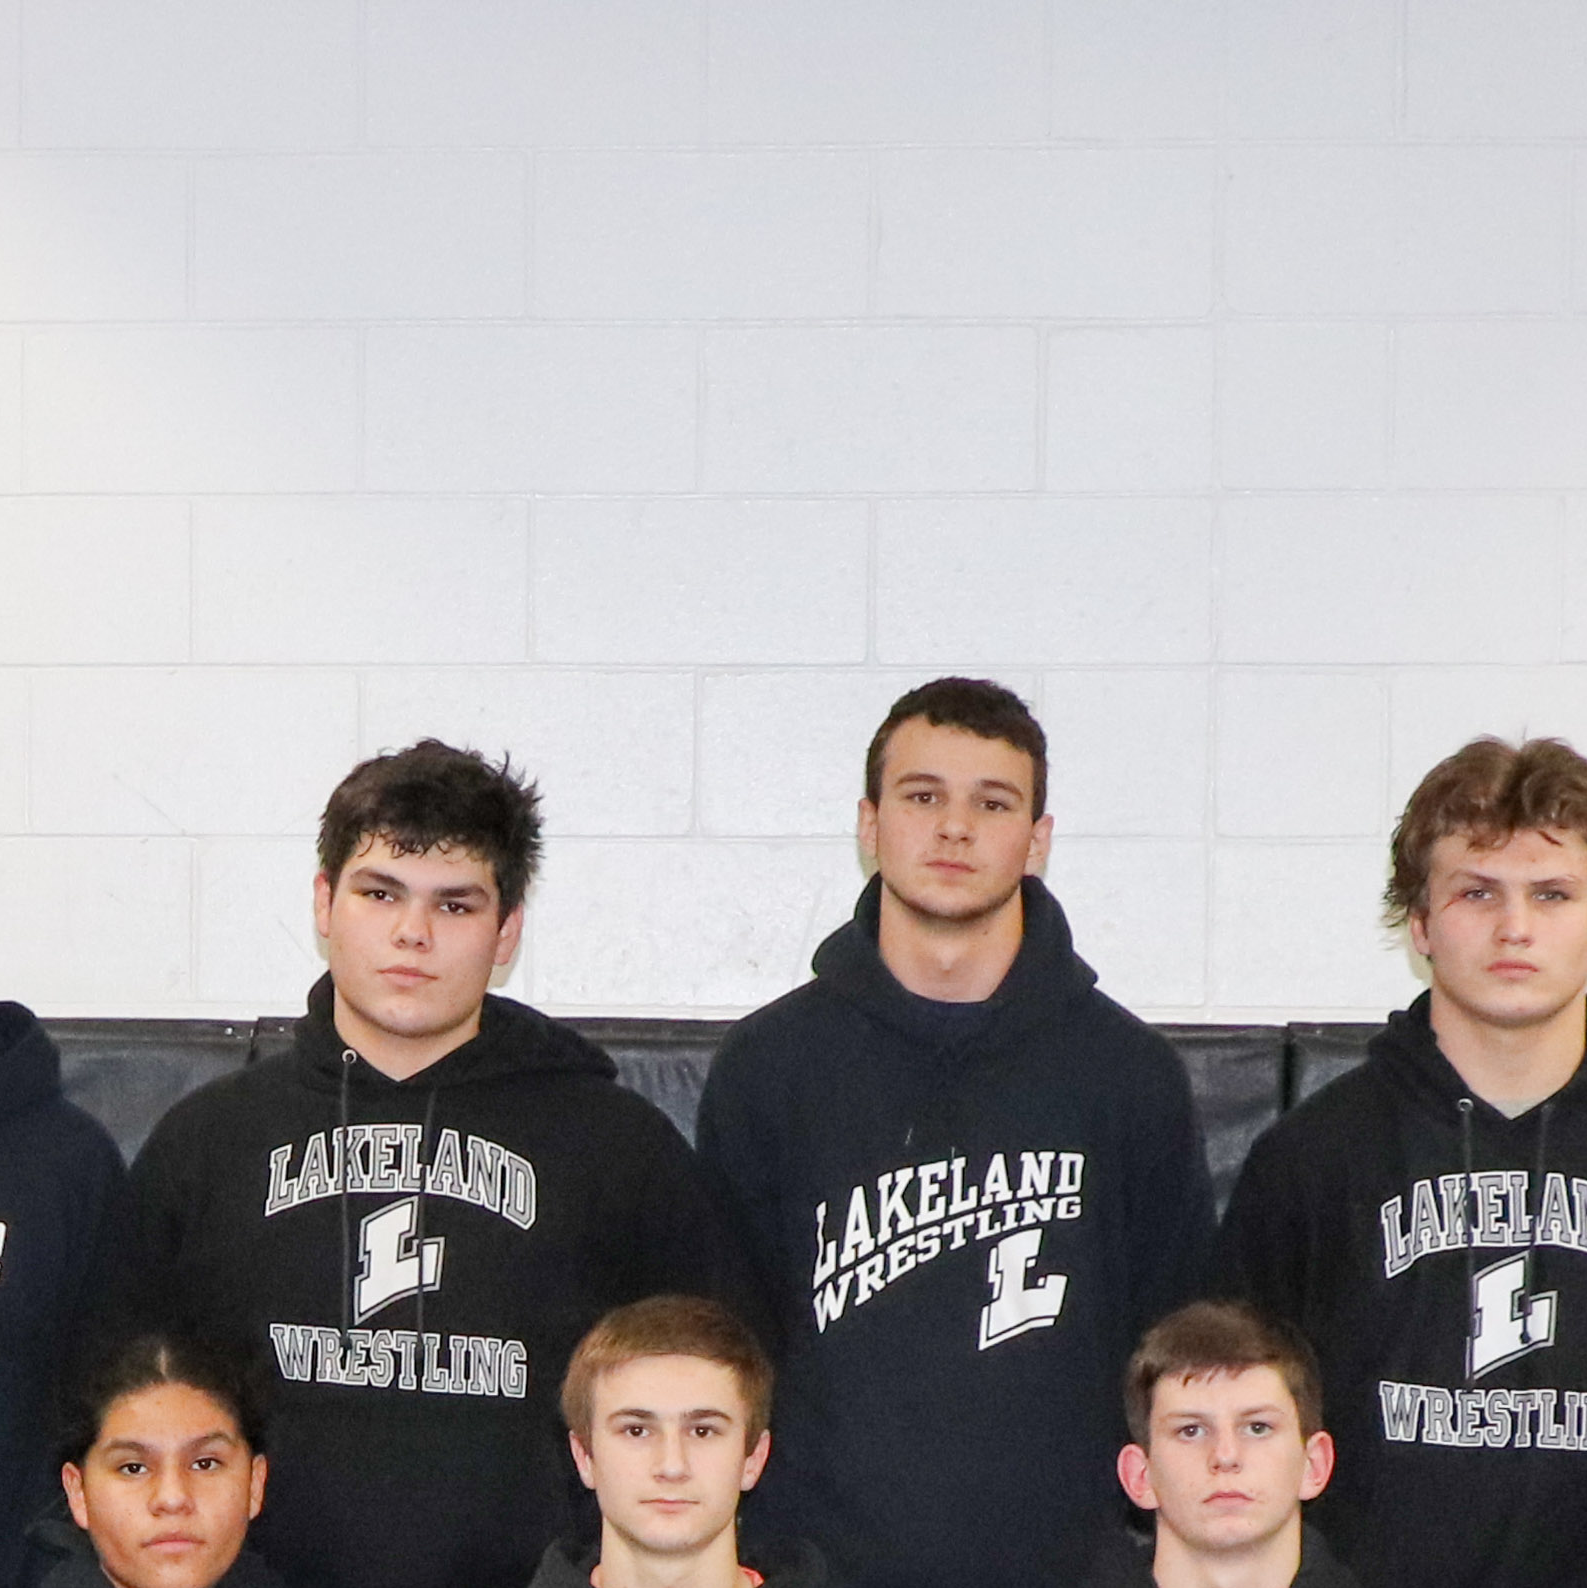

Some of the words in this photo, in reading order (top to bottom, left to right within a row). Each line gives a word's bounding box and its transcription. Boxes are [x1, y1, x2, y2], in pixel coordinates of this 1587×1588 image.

[264, 1123, 536, 1230] LAKELAND
[814, 1151, 1085, 1288] LAKELAND
[814, 1196, 1082, 1333] WRESTLING
[270, 1323, 528, 1398] WRESTLING
